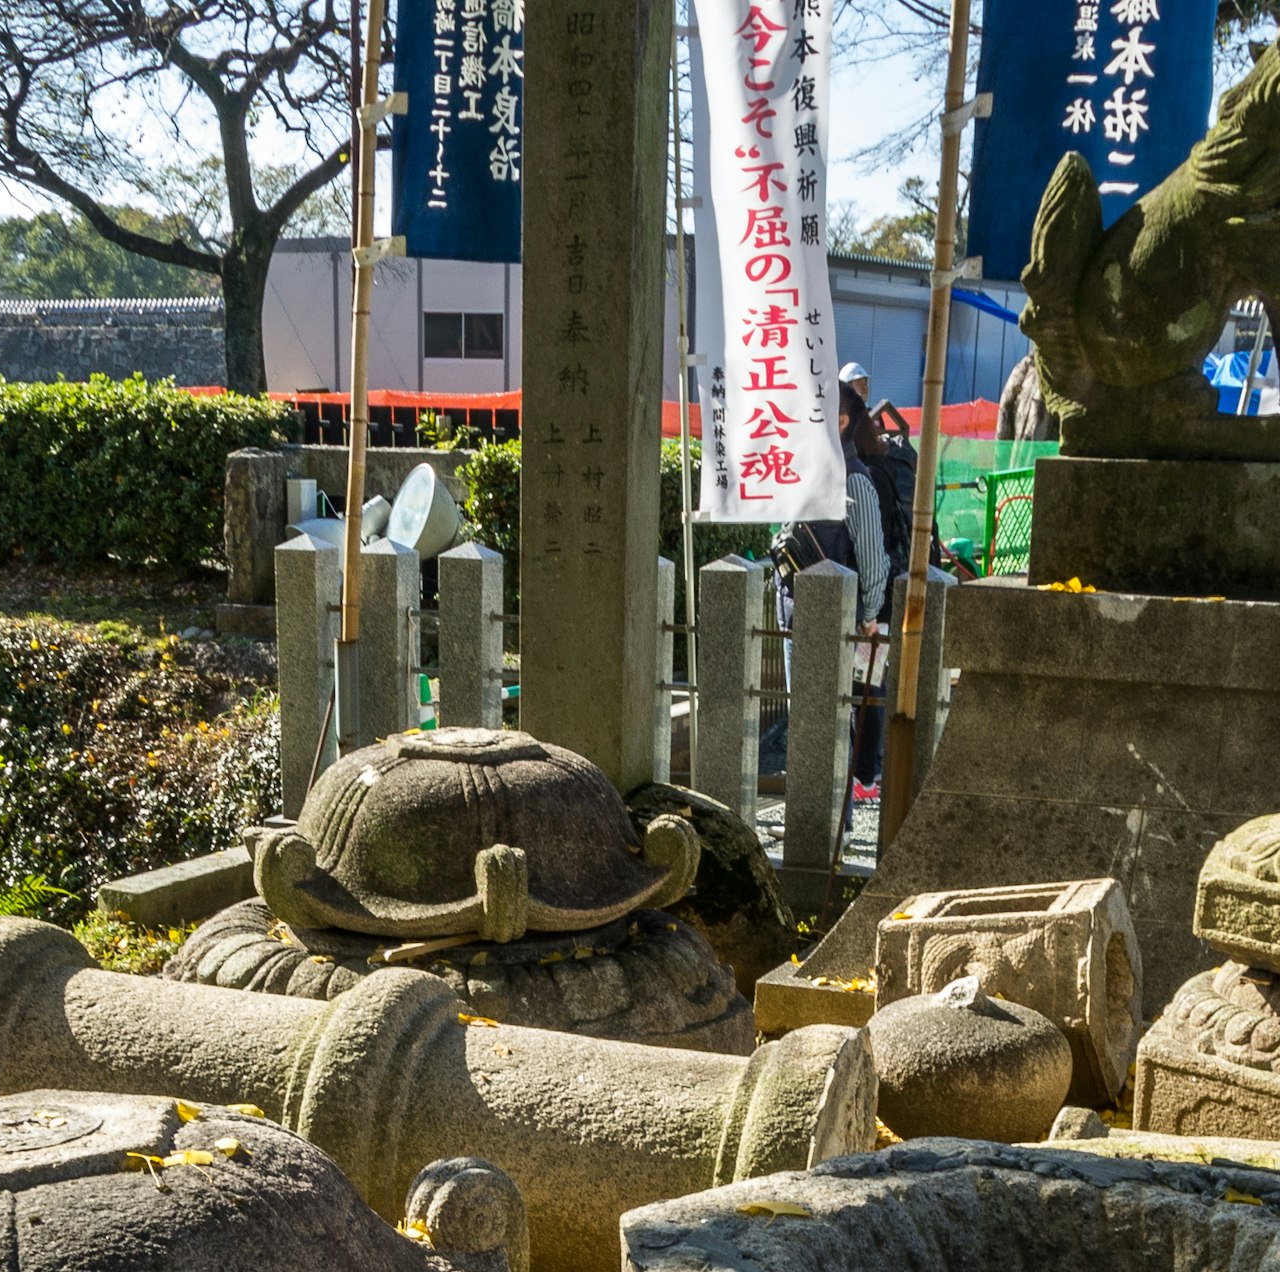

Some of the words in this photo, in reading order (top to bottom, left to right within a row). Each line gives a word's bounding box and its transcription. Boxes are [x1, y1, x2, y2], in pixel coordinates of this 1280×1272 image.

[804, 308, 825, 424] せいしょこ
